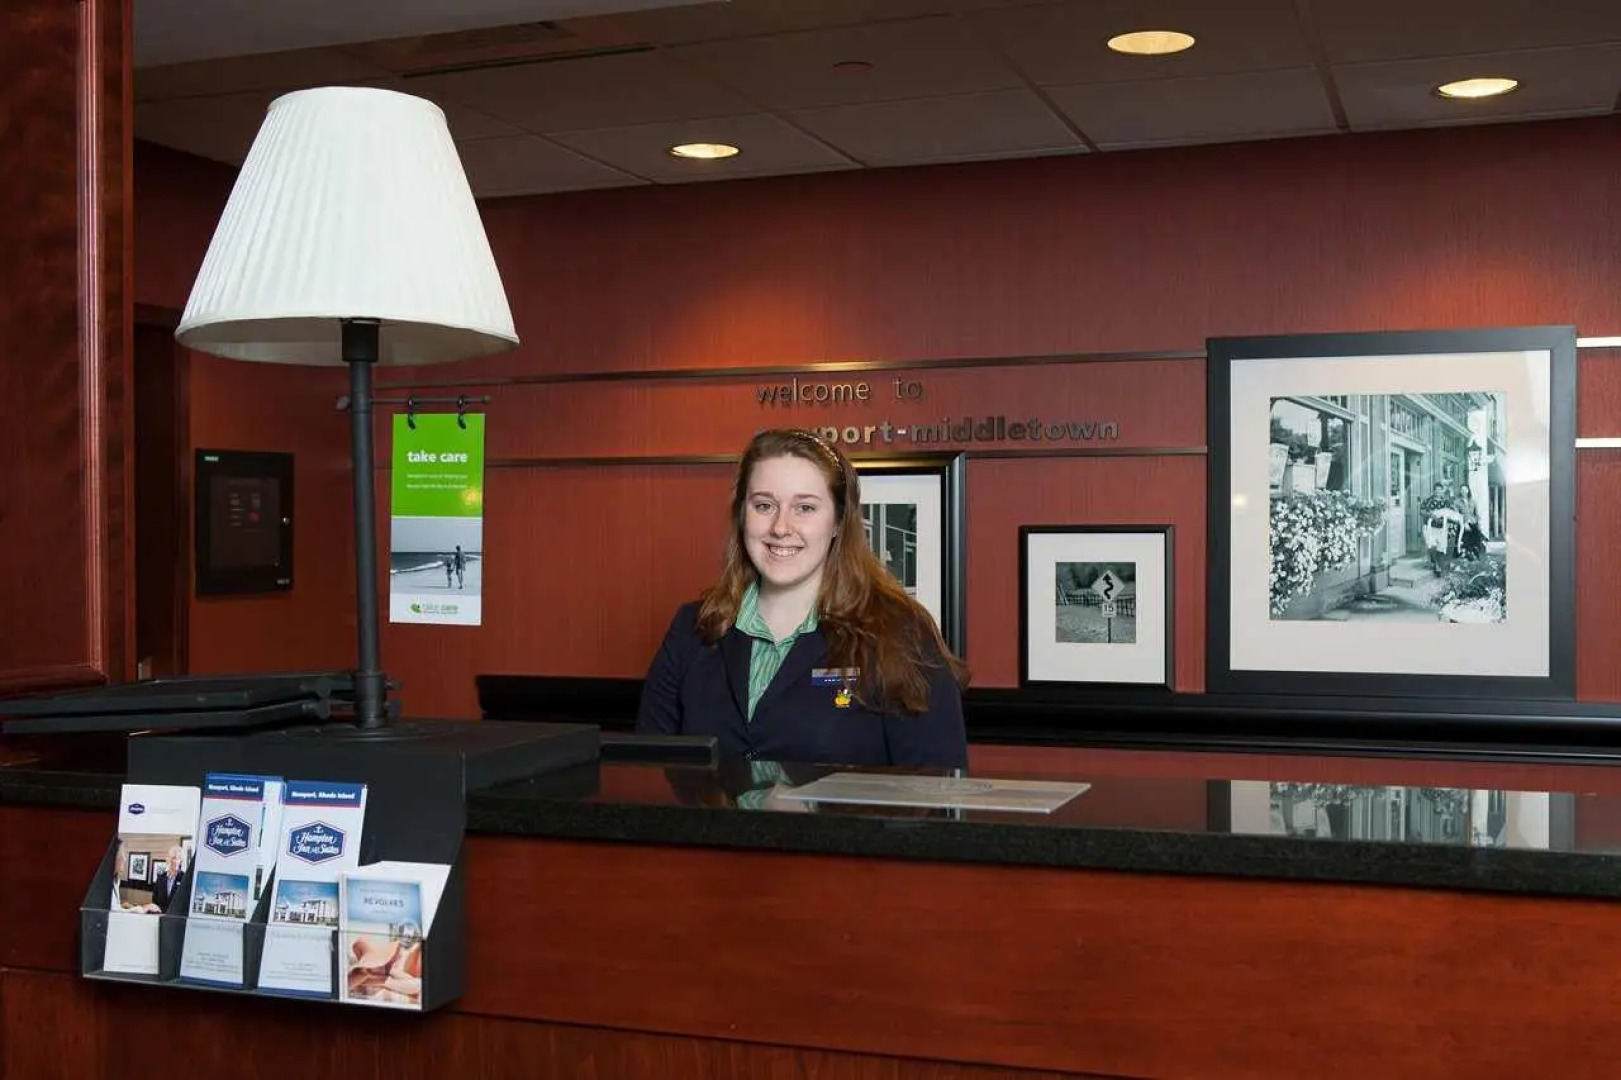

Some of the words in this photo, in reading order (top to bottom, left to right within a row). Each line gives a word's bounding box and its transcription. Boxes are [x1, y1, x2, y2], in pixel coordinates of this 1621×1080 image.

[758, 377, 871, 402] welcome
[892, 376, 922, 400] to
[756, 415, 1119, 445] port-middletown
[408, 449, 437, 463] take
[440, 453, 467, 463] care
[296, 831, 338, 846] Hampton
